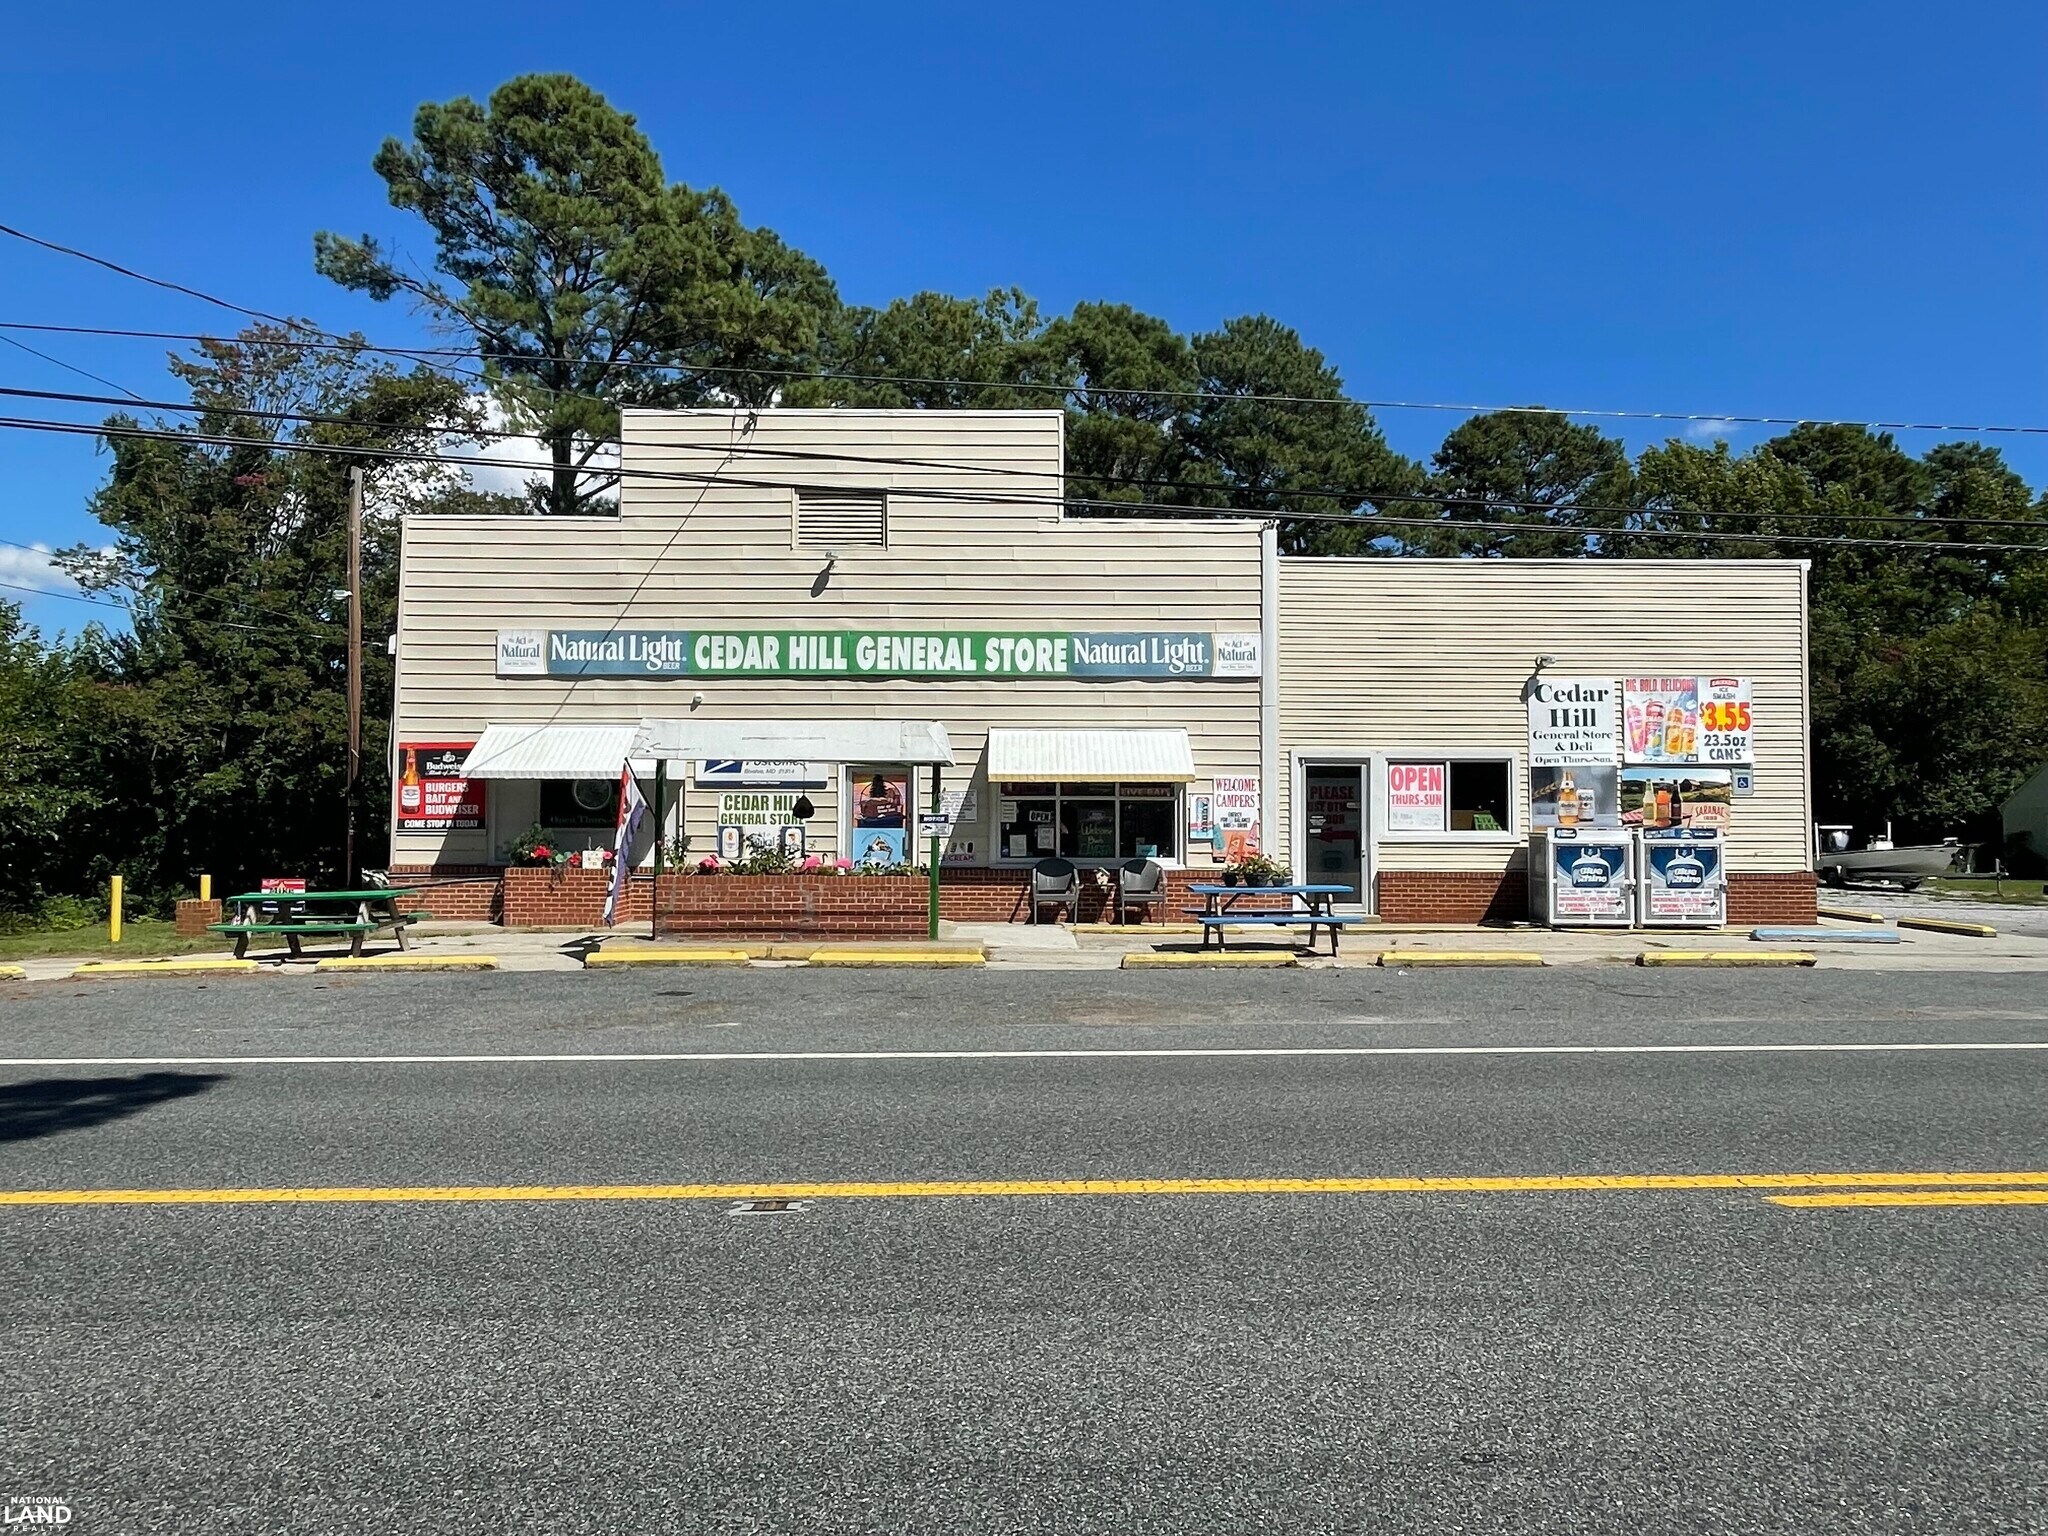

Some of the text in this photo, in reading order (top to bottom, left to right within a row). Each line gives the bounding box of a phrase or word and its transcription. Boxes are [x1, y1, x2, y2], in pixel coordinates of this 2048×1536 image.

[501, 643, 541, 658] Natural
[551, 634, 625, 661] Natural
[694, 634, 1068, 672] CEDAR HILL GENERAL STORE
[1073, 637, 1148, 665] Natural
[1218, 646, 1257, 661] Natural
[662, 662, 681, 670] BEER
[1534, 683, 1609, 703] Cedar
[1548, 708, 1597, 728] Hill
[1699, 701, 1751, 732] $3.55
[1532, 730, 1613, 740] General Store
[1704, 734, 1747, 747] 23.5oz
[1554, 742, 1593, 752] & Deli
[1709, 748, 1743, 760] CANS
[426, 761, 462, 770] Budweis
[1535, 756, 1560, 766] Open
[1215, 778, 1257, 792] WELCOME
[1390, 766, 1442, 792] OPEN
[425, 782, 469, 793] BURGERS
[1310, 785, 1355, 800] PLEASE
[425, 793, 464, 804] BAIT AND
[724, 795, 770, 811] CEDAR
[1216, 794, 1256, 808] CAMPERS
[1391, 794, 1442, 805] THURS-SUN
[425, 804, 479, 815] BUDWEISER
[1327, 801, 1358, 812] OTH
[1695, 805, 1725, 818] SARANAC
[720, 813, 768, 825] GENERAL
[1030, 812, 1050, 821] OPEN
[404, 819, 479, 828] COME STOP IN TODAY
